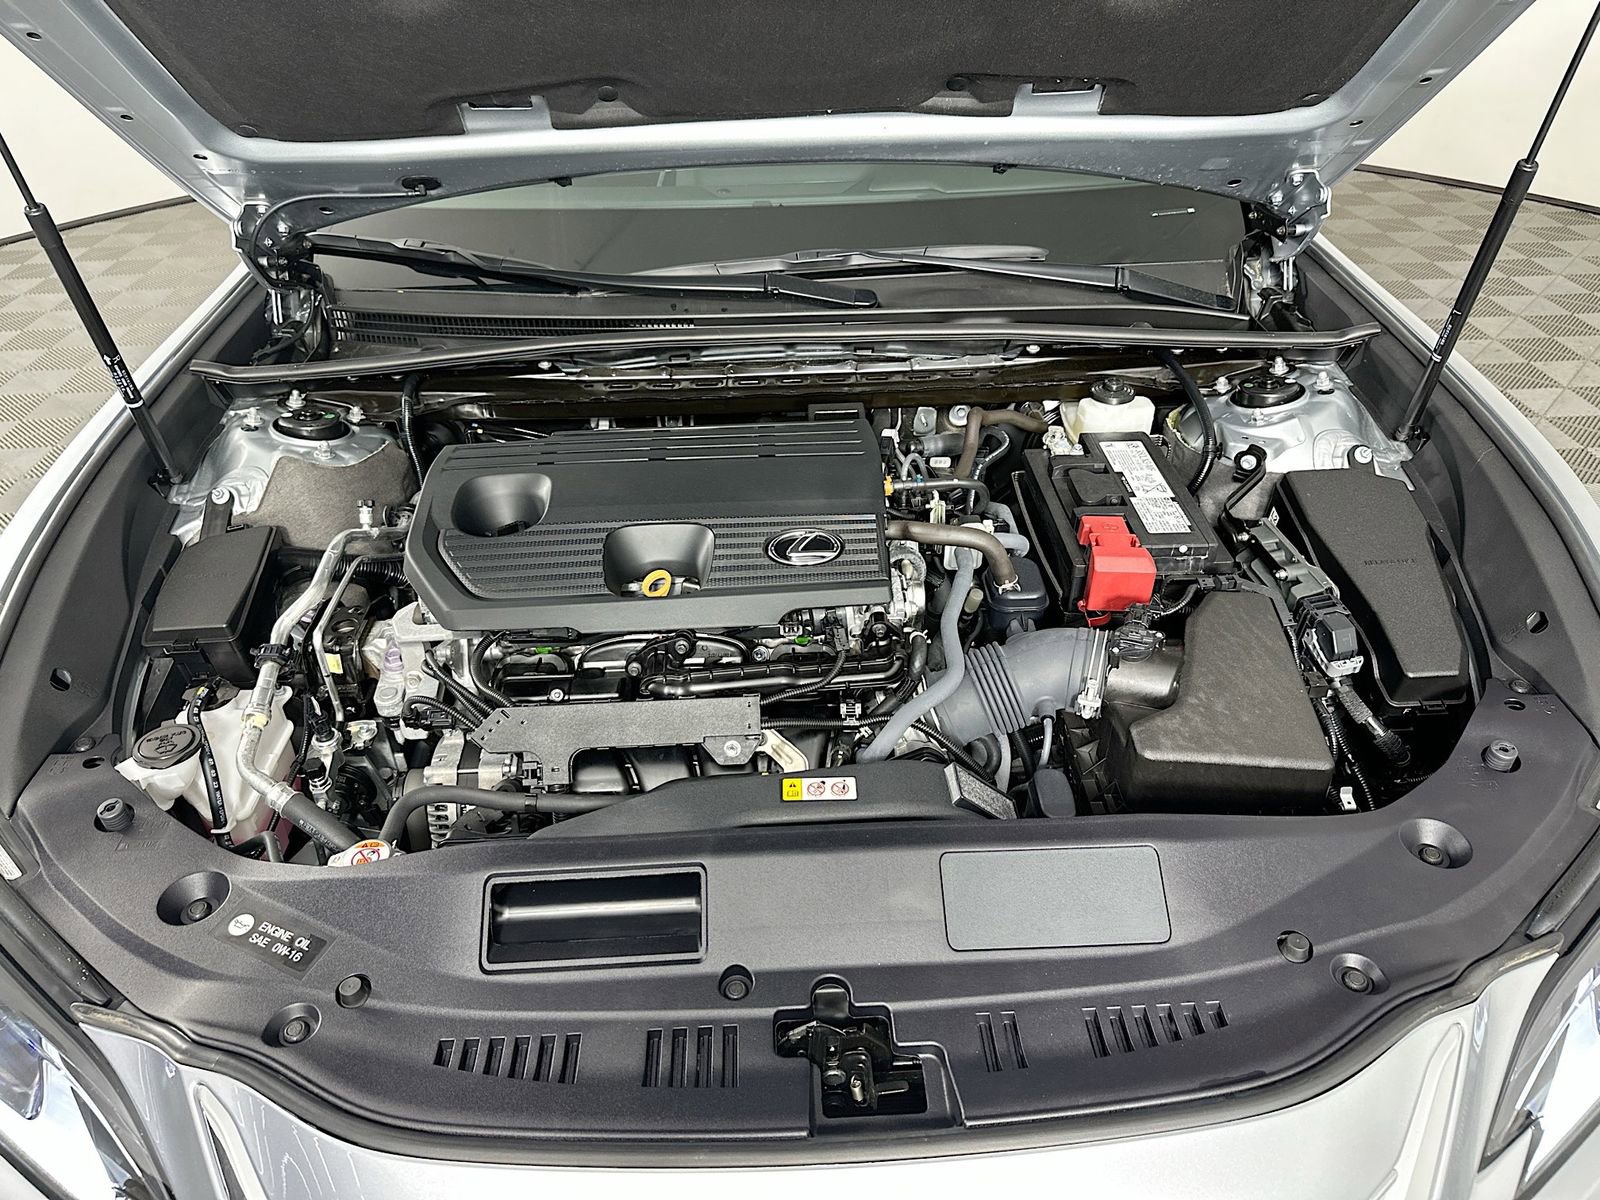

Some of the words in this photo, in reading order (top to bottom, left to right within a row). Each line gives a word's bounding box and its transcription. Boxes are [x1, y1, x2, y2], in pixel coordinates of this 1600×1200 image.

[248, 932, 272, 948] SAE
[271, 942, 304, 962] 0W-16
[258, 921, 295, 943] ENGINE
[294, 936, 312, 951] OIL
